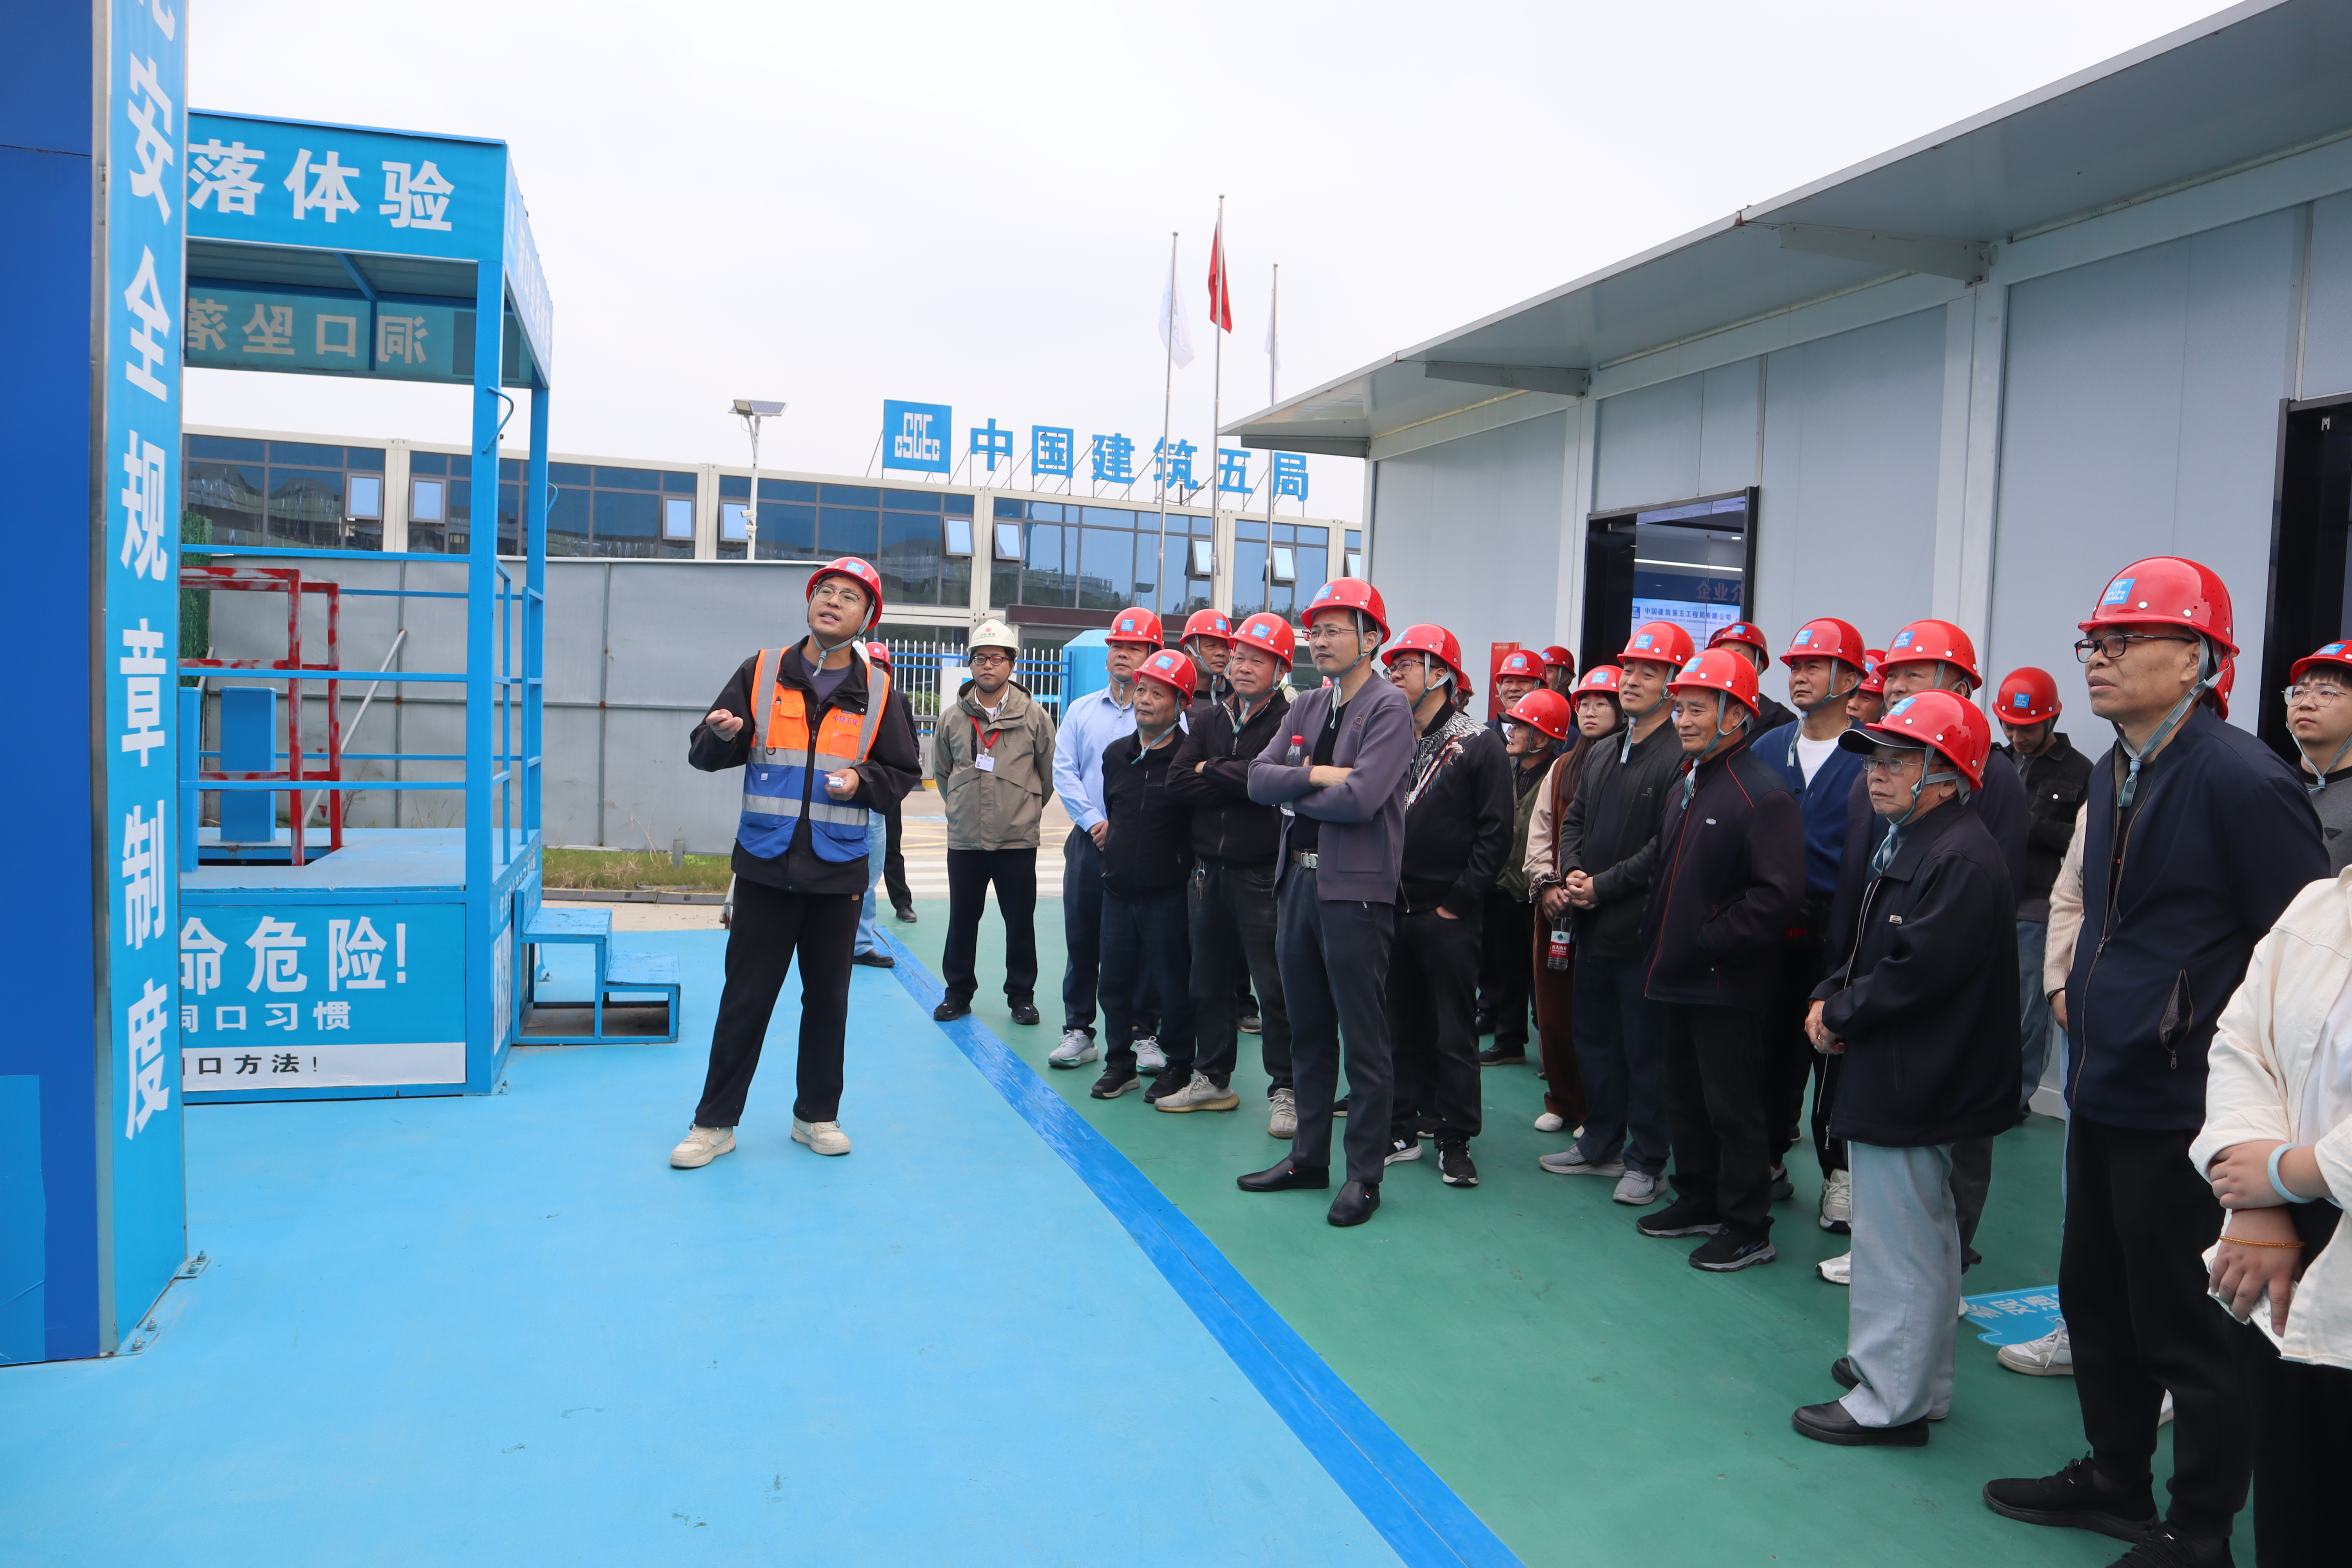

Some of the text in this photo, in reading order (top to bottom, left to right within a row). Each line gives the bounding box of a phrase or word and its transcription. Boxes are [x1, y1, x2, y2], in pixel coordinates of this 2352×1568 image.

[189, 139, 455, 231] 落体验
[970, 418, 1308, 502] 中国建筑五局
[120, 0, 175, 1140] 安全规章制度
[1644, 607, 1731, 621] 中国建筑第五工程局有限公司
[833, 715, 858, 726] 中建五局
[183, 1053, 317, 1076] 口方法!
[1967, 1293, 2060, 1319] 参观通
